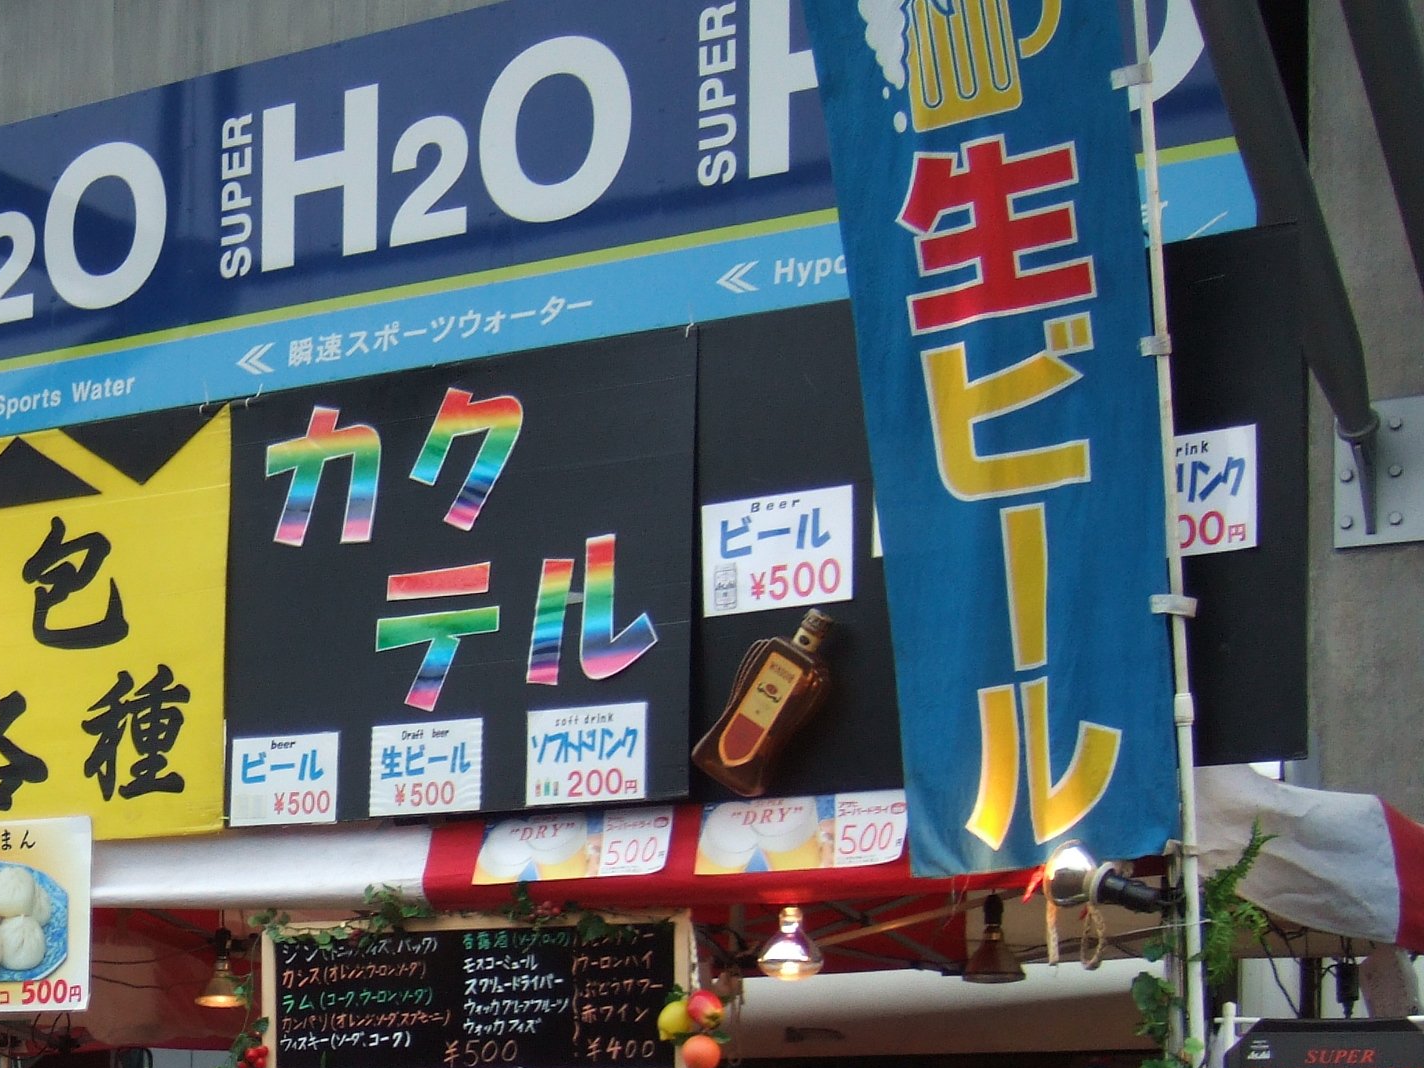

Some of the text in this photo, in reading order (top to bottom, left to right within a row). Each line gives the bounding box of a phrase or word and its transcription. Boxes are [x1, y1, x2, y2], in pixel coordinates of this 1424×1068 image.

[698, 0, 738, 186] SUPER
[262, 35, 632, 273] H2O
[220, 114, 253, 279] SUPER
[288, 296, 592, 367] 瞬速スポーツウォーター
[72, 376, 136, 403] Water
[750, 498, 800, 513] Beer
[896, 135, 1123, 852] 生ビール
[719, 507, 831, 560] ビール
[750, 557, 842, 601] ¥500
[583, 712, 615, 725] drink
[270, 738, 297, 750] beer
[531, 726, 639, 765] ソフトドリンク
[241, 748, 324, 785] ビール
[380, 741, 471, 780] 生ビール
[394, 780, 456, 808] ¥500
[567, 767, 638, 798] 200円
[273, 790, 331, 816] ¥500
[21, 979, 82, 1005] 500円
[444, 1038, 518, 1068] ¥500
[586, 1036, 656, 1063] ¥400
[1305, 1048, 1376, 1064] SUPER
